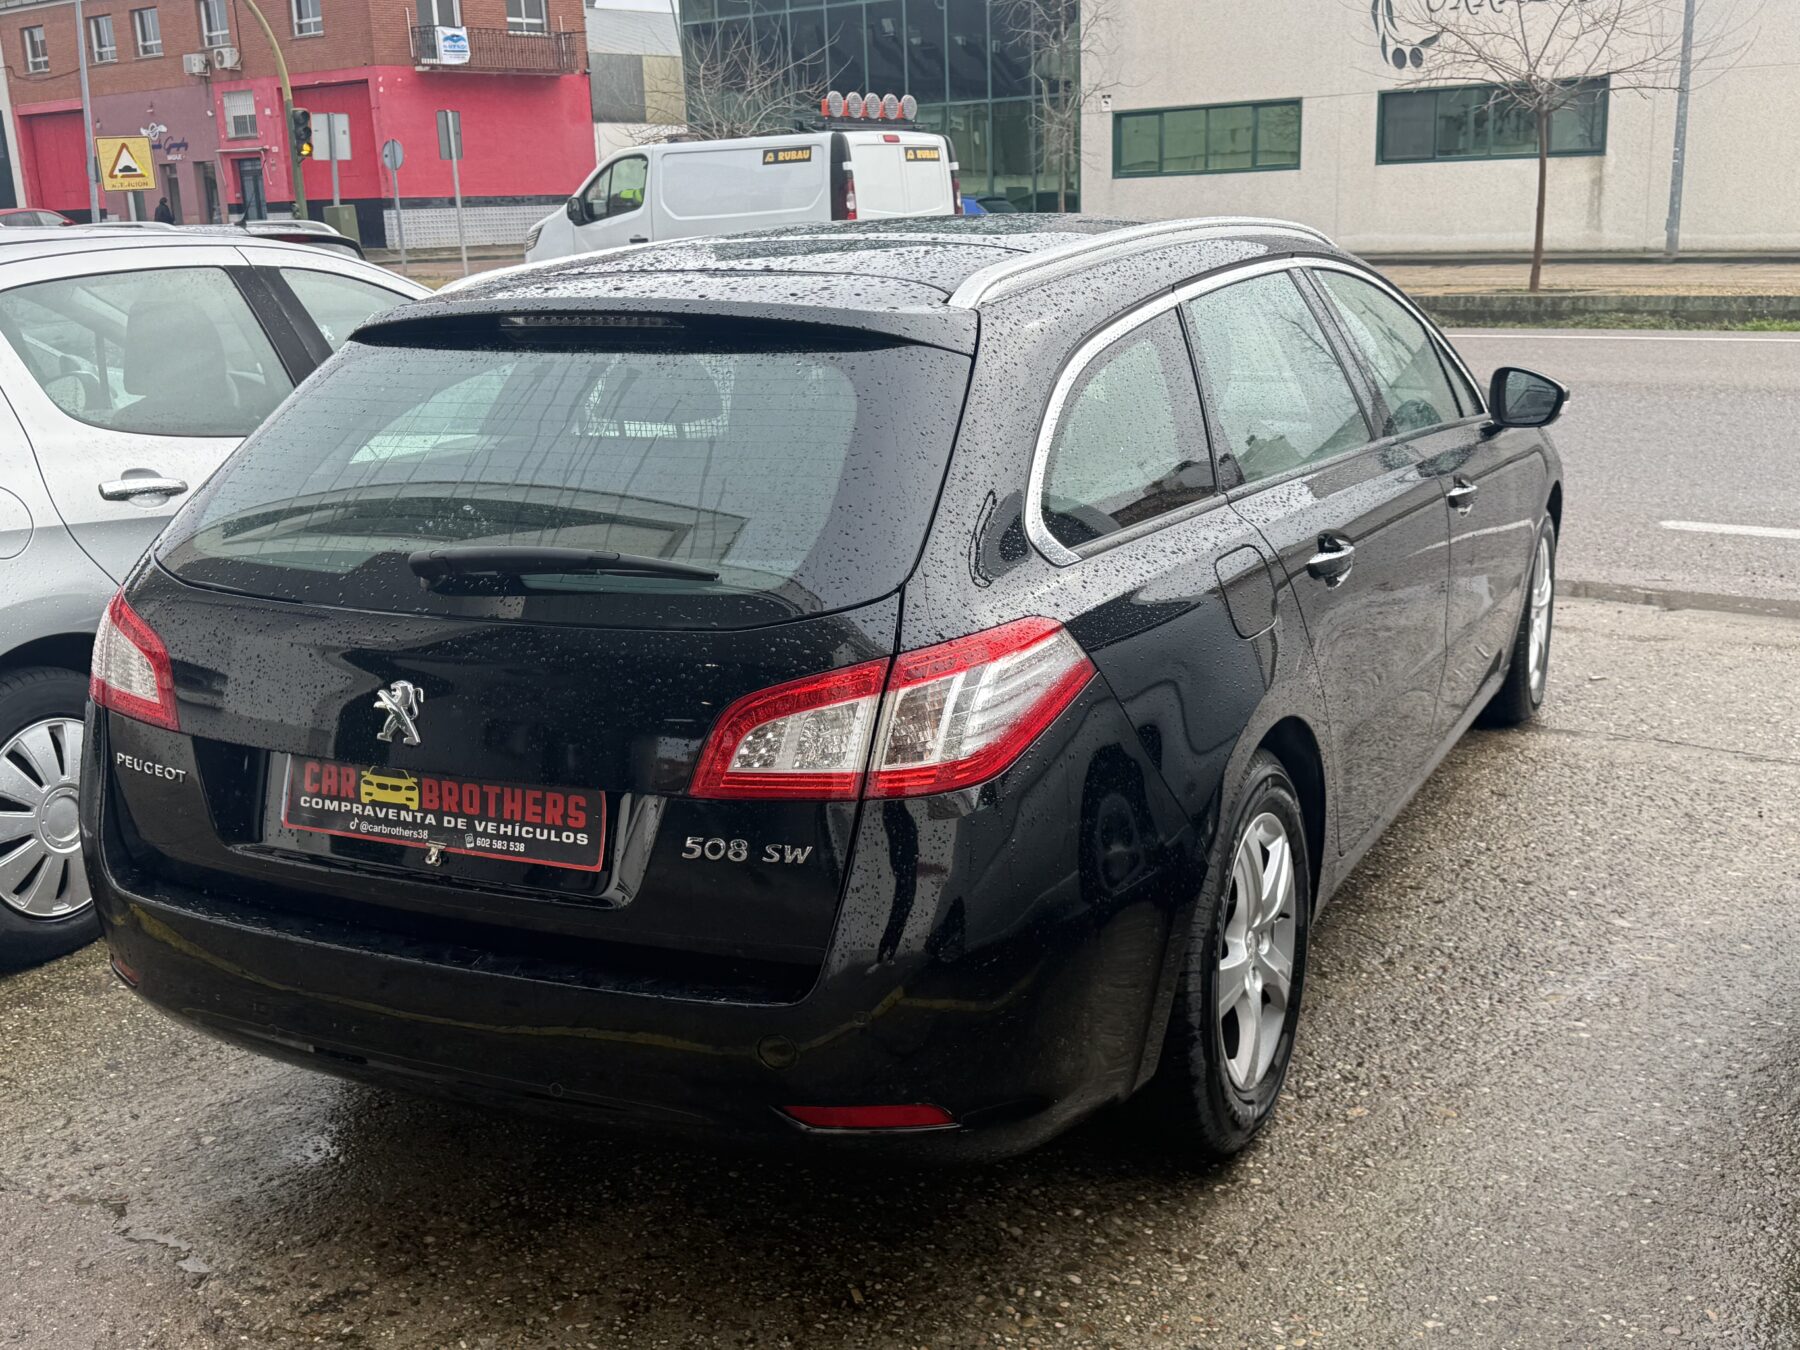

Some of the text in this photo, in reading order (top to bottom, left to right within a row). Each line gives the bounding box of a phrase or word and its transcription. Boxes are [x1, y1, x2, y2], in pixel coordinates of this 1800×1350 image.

[778, 149, 810, 161] RUBAU
[117, 752, 186, 782] PEUGEOT
[304, 762, 587, 829] CAR BROTHERS
[300, 796, 589, 845] COMPRAVENTA DE VEHÍCULOS
[360, 821, 429, 840] @carbrothers38
[476, 836, 525, 852] 602 583 538
[682, 836, 813, 864] 508 SW
